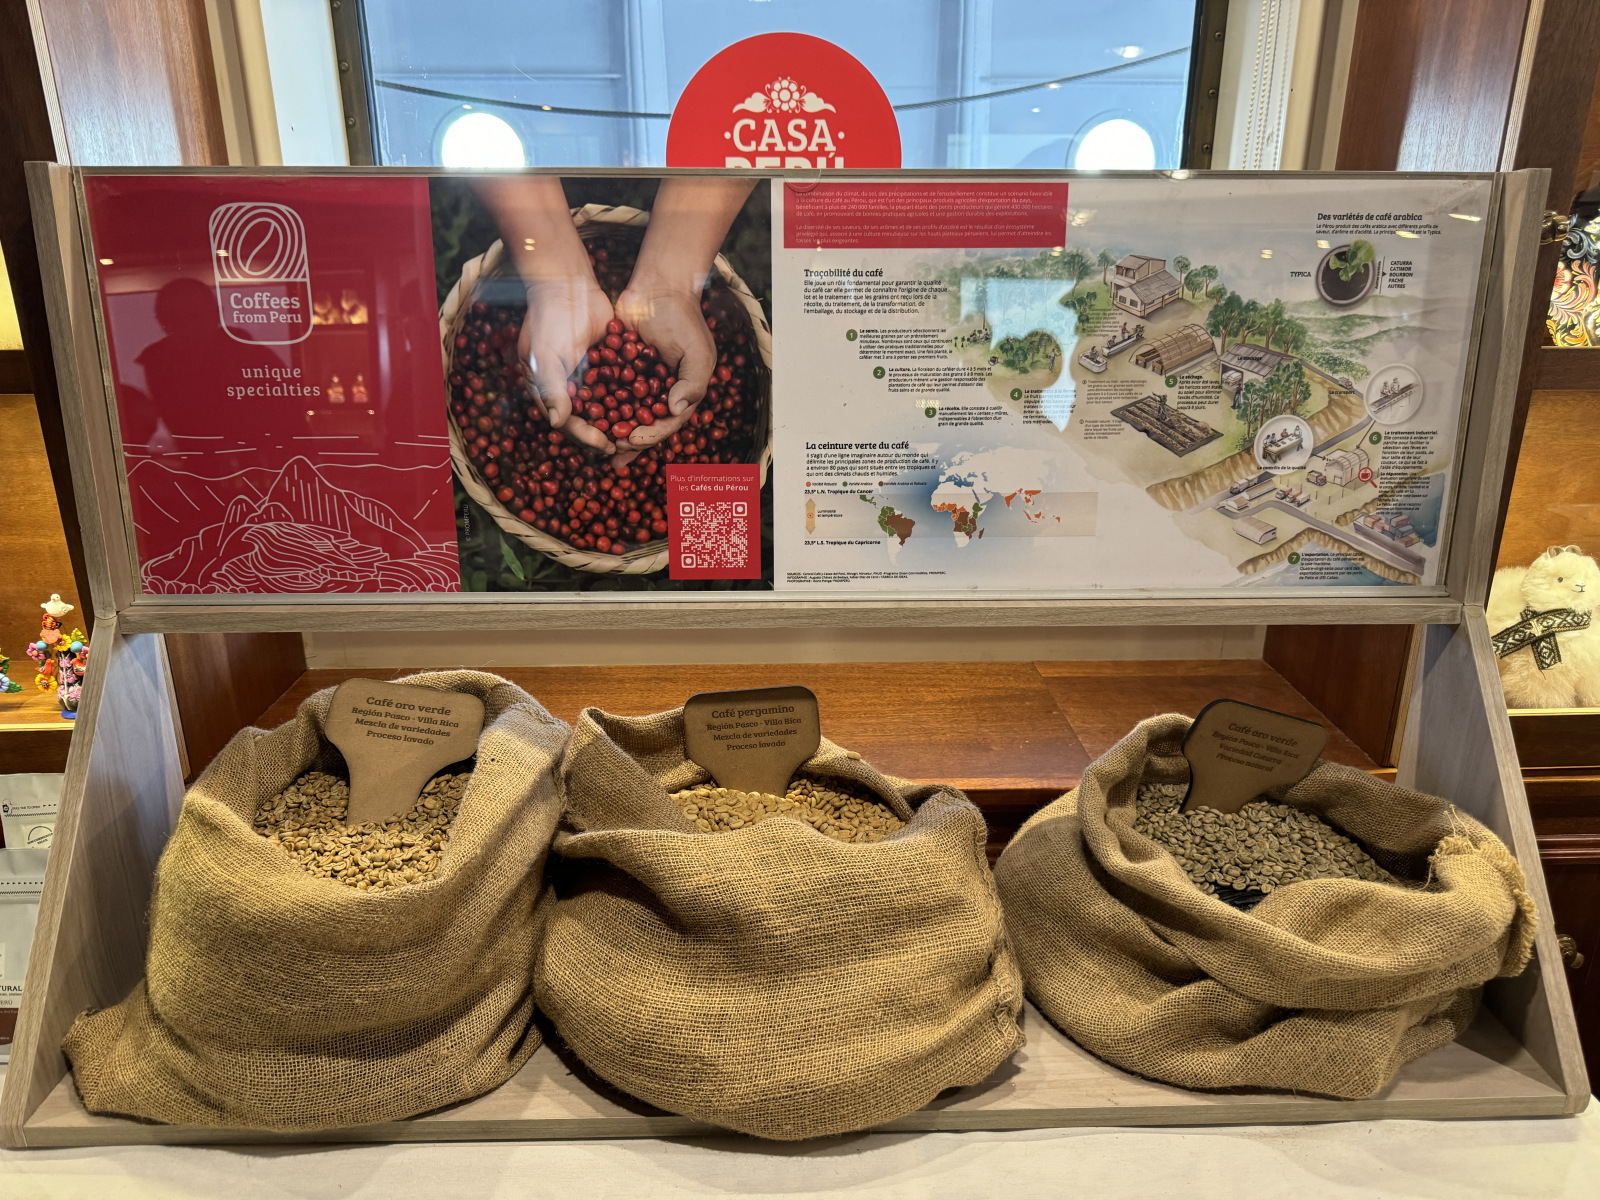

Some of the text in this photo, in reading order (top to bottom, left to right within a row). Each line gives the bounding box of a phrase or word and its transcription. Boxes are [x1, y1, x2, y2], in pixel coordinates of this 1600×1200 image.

[733, 118, 836, 152] CASA
[804, 269, 850, 279] Traçabilité
[230, 292, 300, 309] Coffees
[233, 311, 302, 323] from Peru
[241, 365, 301, 381] unique
[227, 383, 320, 400] specialties
[366, 697, 452, 716] Café oro verde
[711, 706, 795, 719] Café pergamino
[351, 707, 383, 718] Región
[384, 712, 410, 721] Pasco
[417, 716, 438, 725] Villa
[439, 719, 459, 728] Rica
[355, 718, 387, 728] Mezcla
[401, 726, 451, 736] variedades
[706, 724, 735, 732] Región
[753, 729, 798, 738] variedades
[1228, 722, 1298, 747] Café oro verde
[366, 730, 434, 745] Proceso lavado
[1212, 731, 1238, 742] Región
[1239, 738, 1261, 748] Pasco
[1266, 745, 1282, 754] Villa
[1283, 750, 1299, 758] Rica
[1220, 743, 1282, 764] Variedad Caturra
[1216, 753, 1274, 772] Proceso natural
